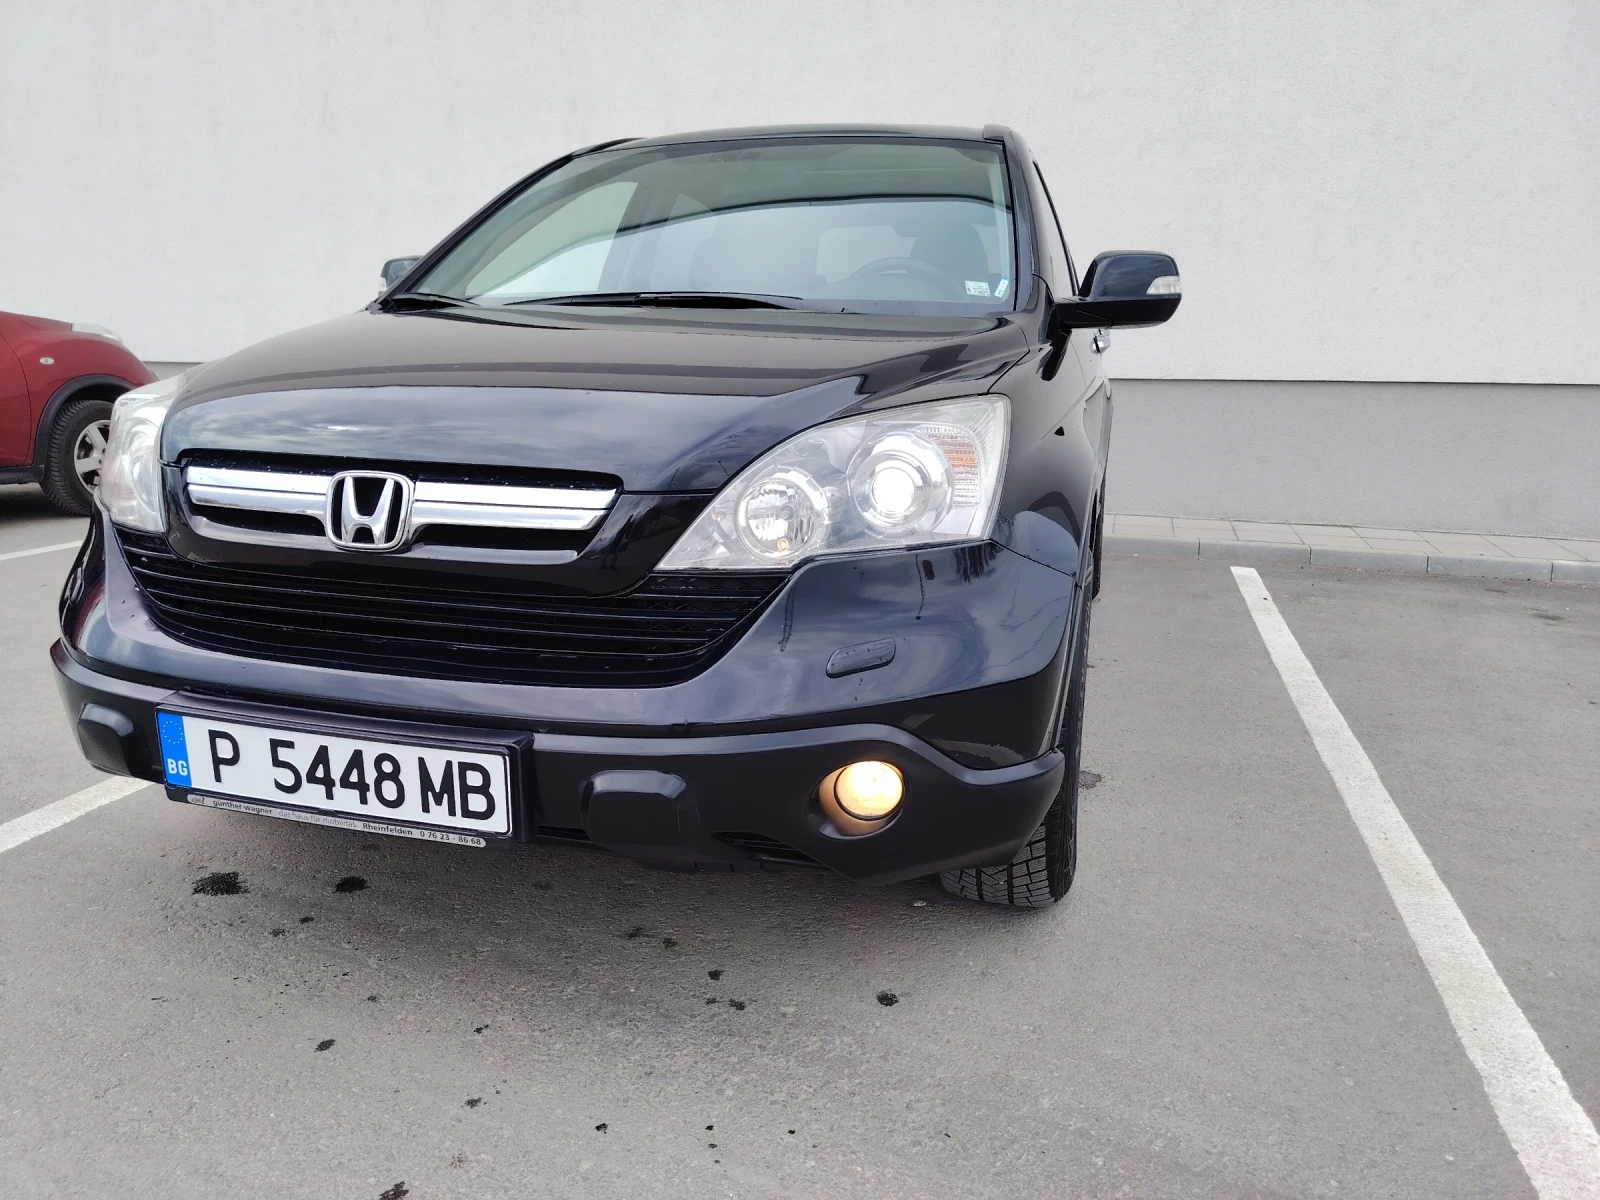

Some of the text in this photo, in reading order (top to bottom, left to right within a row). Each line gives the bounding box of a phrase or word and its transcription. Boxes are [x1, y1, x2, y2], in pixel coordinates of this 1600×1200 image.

[166, 758, 188, 777] BG
[208, 729, 497, 821] P 5448 MB
[245, 804, 273, 815] wagner
[278, 809, 291, 818] das
[292, 811, 309, 821] haus
[362, 822, 413, 836] Rheinfelden
